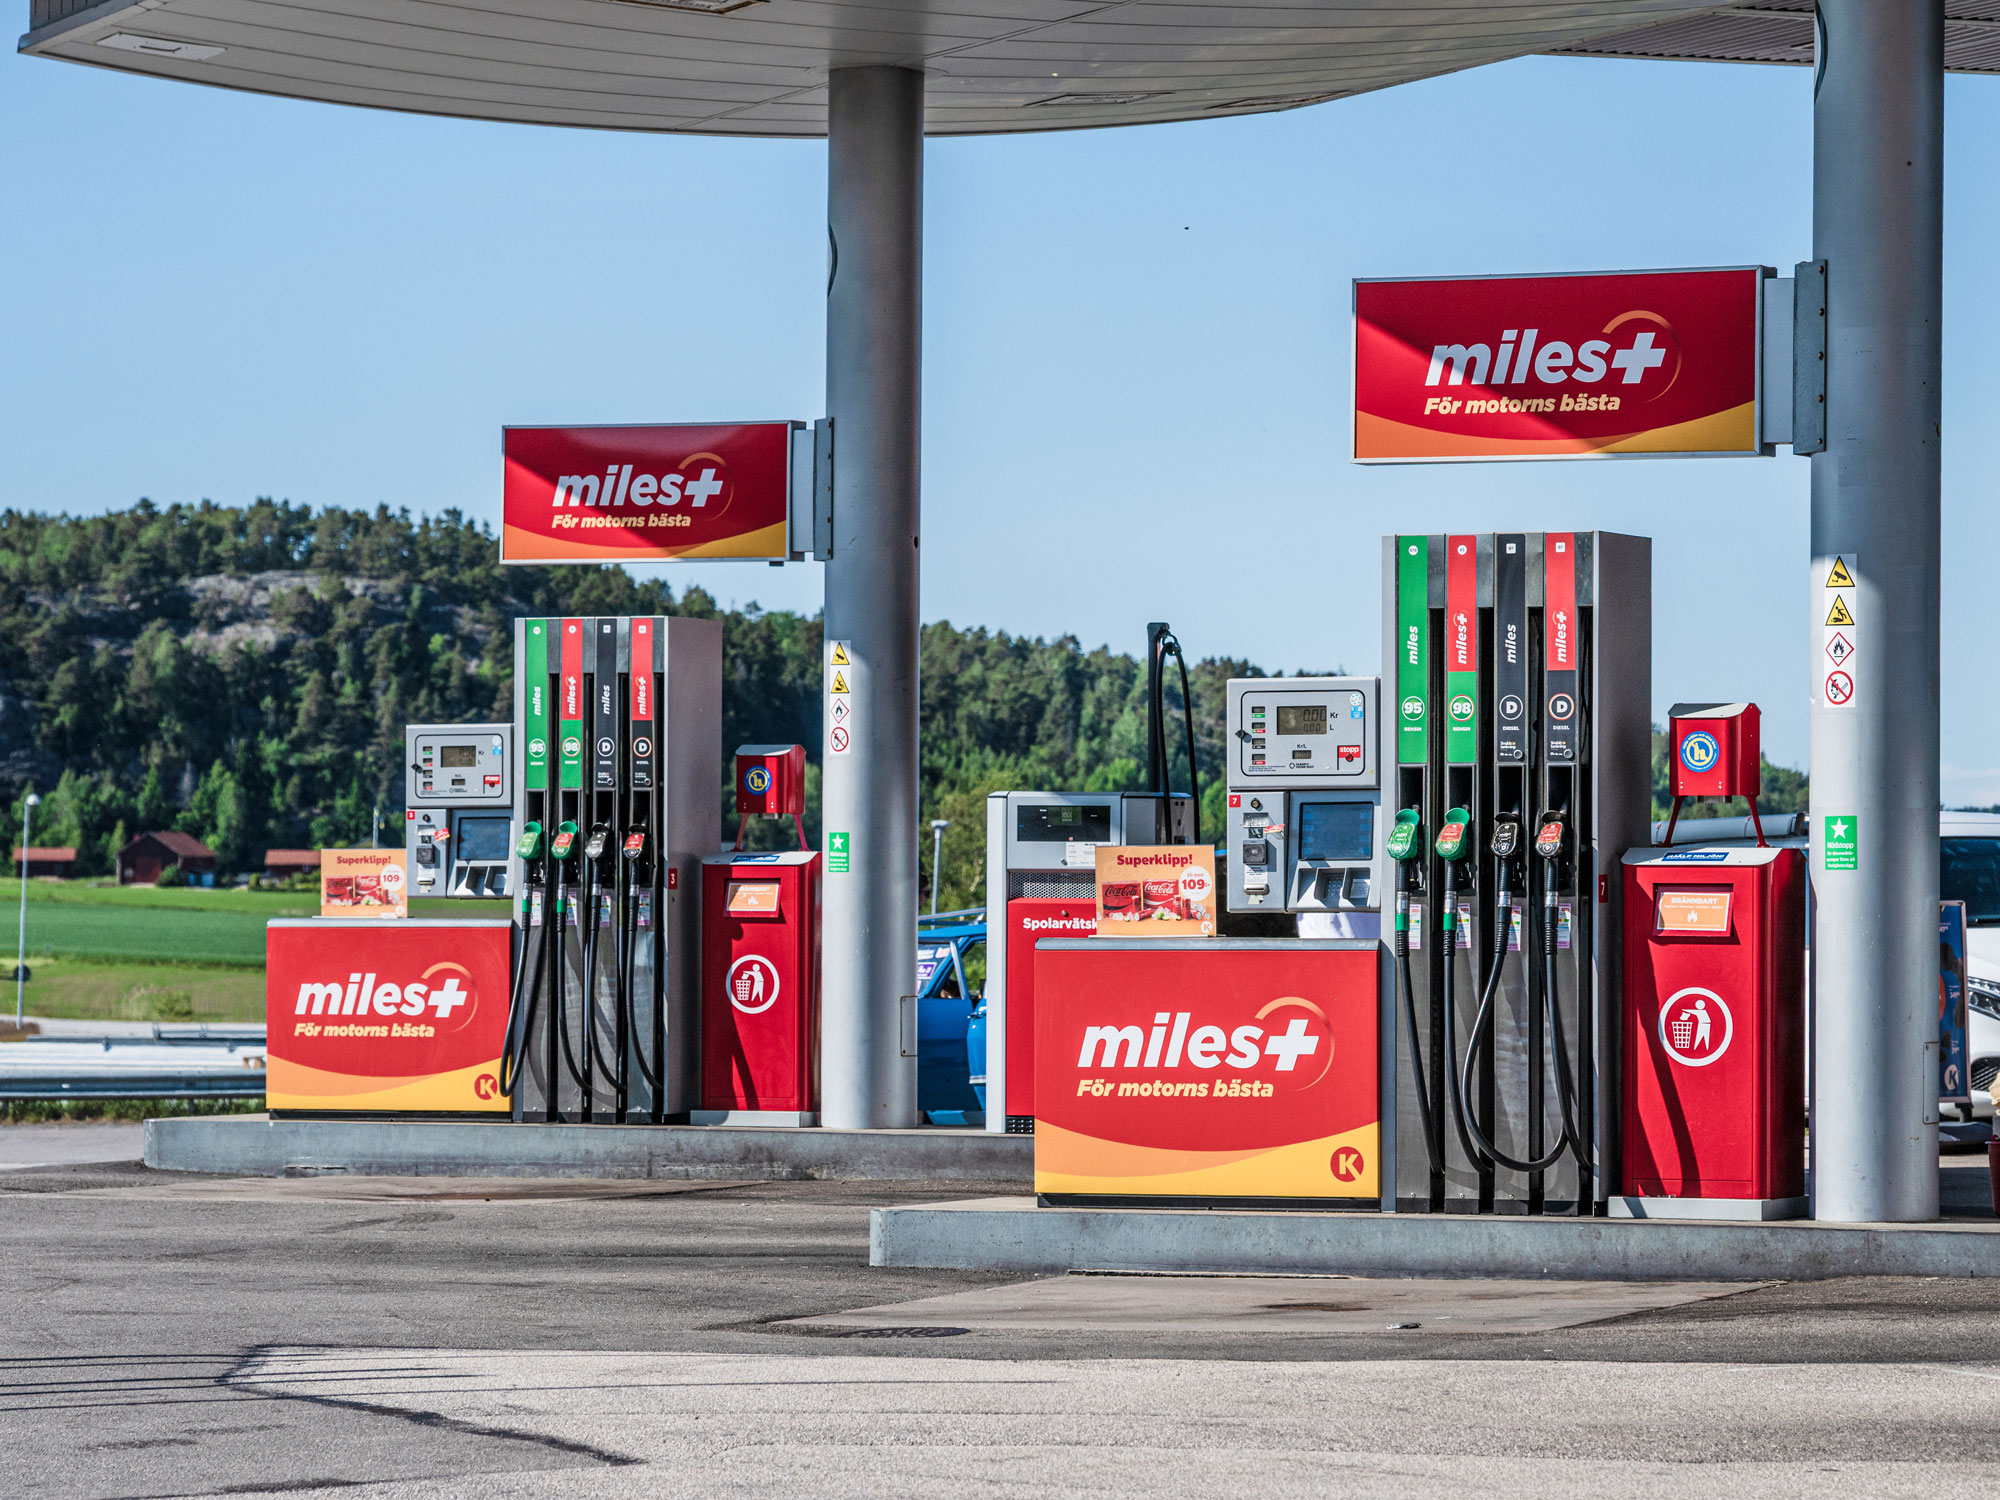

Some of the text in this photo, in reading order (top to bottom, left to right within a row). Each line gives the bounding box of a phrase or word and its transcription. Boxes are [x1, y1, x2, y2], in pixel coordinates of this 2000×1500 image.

[1424, 394, 1621, 415] För motorns bästa
[552, 513, 691, 528] För motorns bästa
[1407, 625, 1418, 665] miles
[1505, 624, 1516, 663] miles
[533, 686, 541, 715] miles
[602, 685, 610, 715] miles
[1556, 700, 1568, 713] D
[1404, 701, 1423, 714] 95
[1452, 702, 1472, 715] 98
[1506, 701, 1518, 714] D
[530, 742, 544, 752] 95
[564, 742, 578, 752] 98
[602, 742, 611, 752] D
[639, 742, 647, 752] D
[337, 855, 391, 866] Superklipp!
[1117, 854, 1192, 867] Superklipp!
[671, 873, 675, 884] 3
[1600, 881, 1606, 896] 7
[294, 1023, 435, 1038] För motorns bästa
[477, 1077, 498, 1099] K
[1077, 1079, 1273, 1098] För motorns bästa
[1336, 1151, 1362, 1179] K
